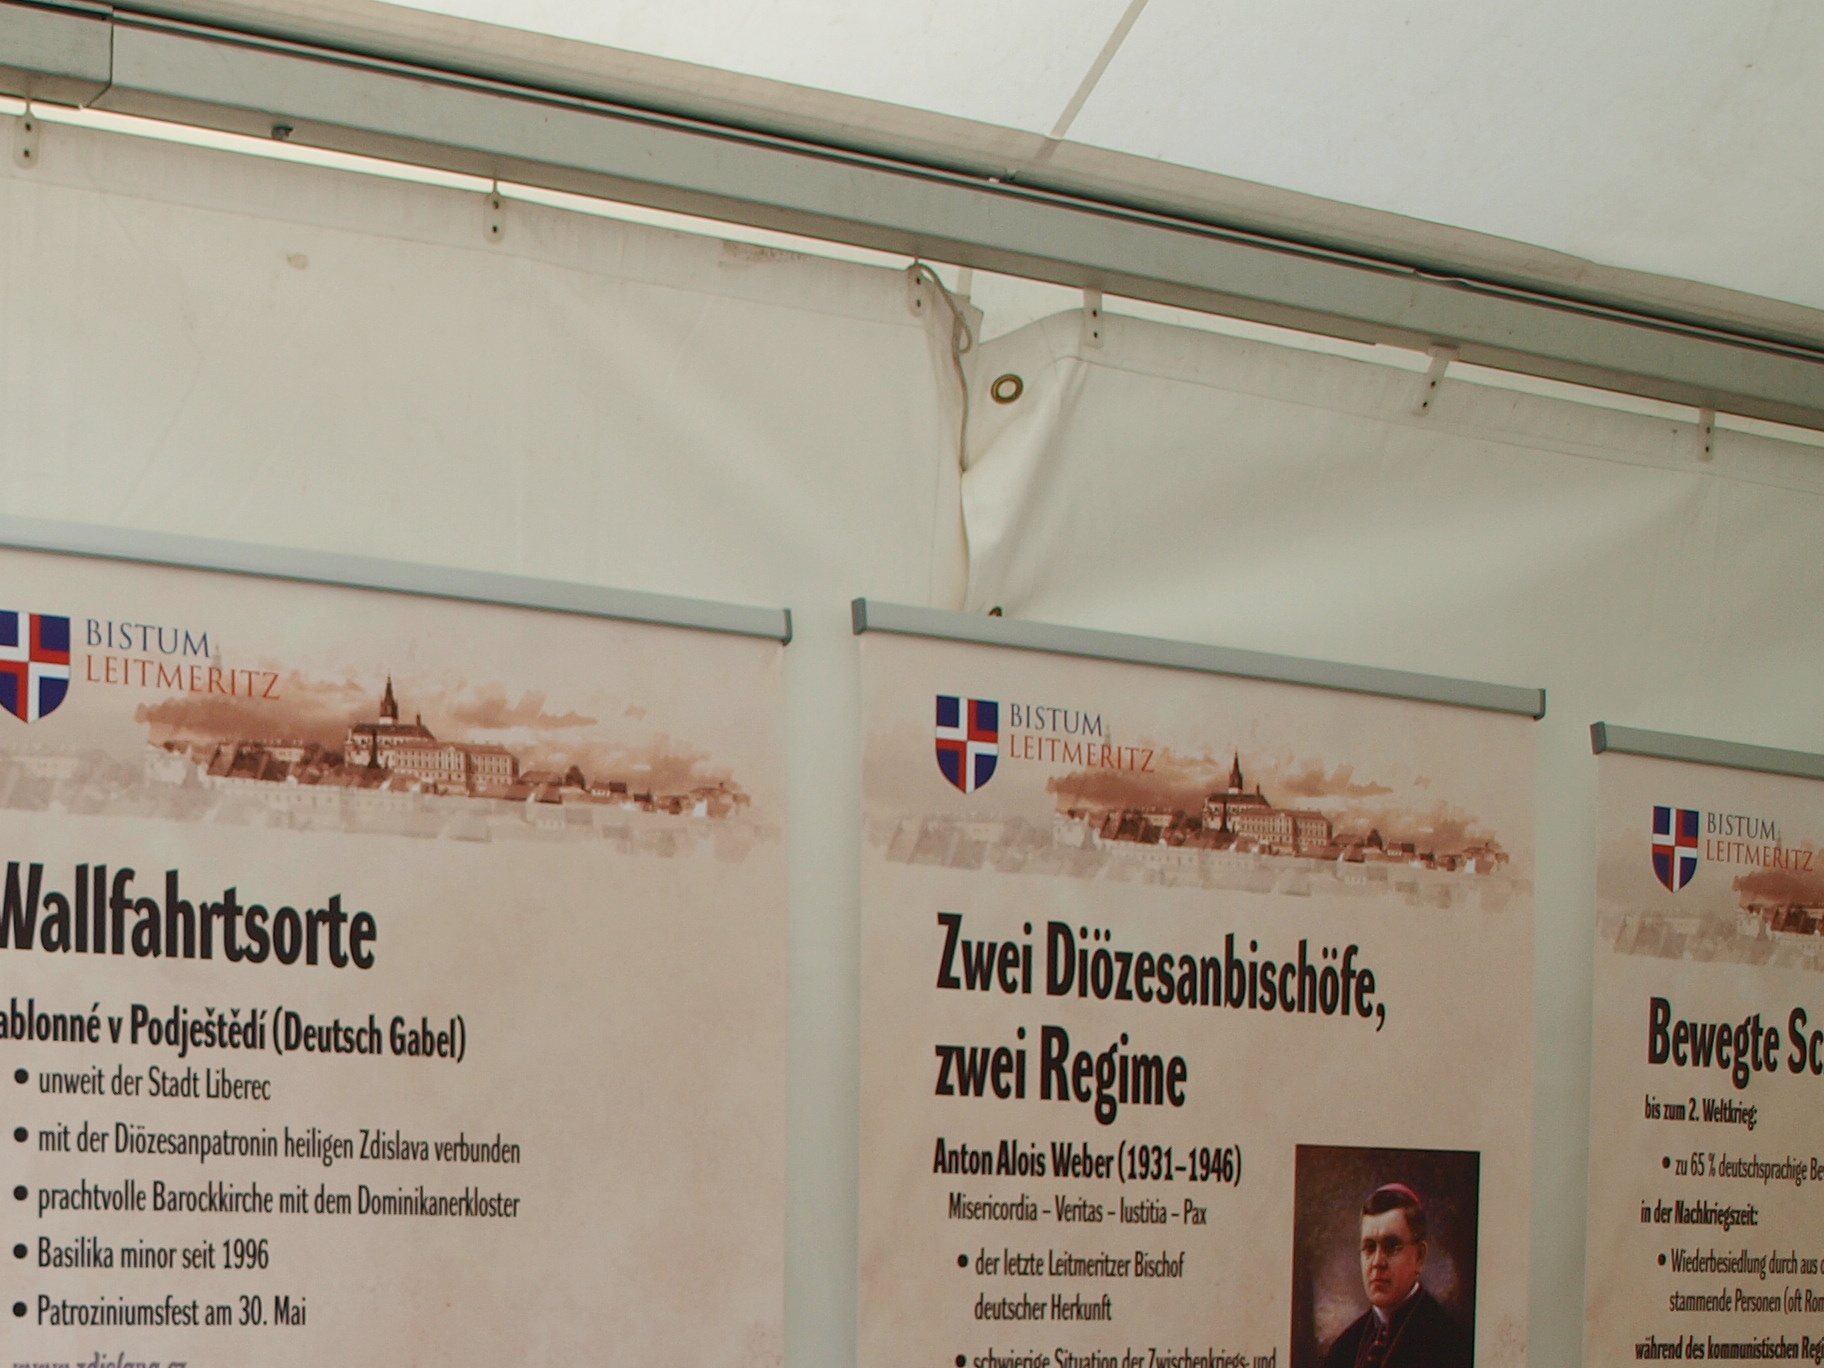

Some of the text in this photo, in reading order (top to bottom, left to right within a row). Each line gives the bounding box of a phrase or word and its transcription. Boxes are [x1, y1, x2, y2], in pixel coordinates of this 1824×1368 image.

[86, 618, 210, 658] BISTUM
[86, 653, 281, 701] LEITMERITZ
[1010, 702, 1102, 737] BISTUM
[1010, 733, 1154, 774] LEITMERITZ
[1707, 811, 1776, 840] BISTUM
[1706, 838, 1813, 872] LEITMERITZ
[936, 911, 1386, 1032] Zwei Diözesanbischöfe,
[108, 1016, 122, 1043] v
[130, 1004, 266, 1057] Podještědí
[272, 1006, 382, 1054] (Deutsch
[389, 1015, 465, 1062] Gabel)
[1648, 996, 1824, 1090] Bewegte Sc
[39, 1063, 270, 1100] unweit der Stadt Liberec
[935, 1025, 1187, 1126] zwei Regime
[1644, 1094, 1660, 1119] bis
[1663, 1103, 1685, 1120] zum
[39, 1120, 520, 1166] mit der Diözesanpatronin heiligen Zdislava verbunden
[933, 1137, 992, 1174] Anton
[996, 1139, 1045, 1176] Alois
[1050, 1141, 1114, 1178] Weber
[38, 1178, 520, 1217] prachtvolle Barockkirche mit dem Dominikanerkloster
[38, 1236, 268, 1269] Basilika minor seit 1996
[975, 1247, 1185, 1277] der letzte Leitmeritzer Bischof
[38, 1294, 305, 1325] Patroziniumsfest am 30. Mai
[974, 1292, 1111, 1320] deutscher Herkunft
